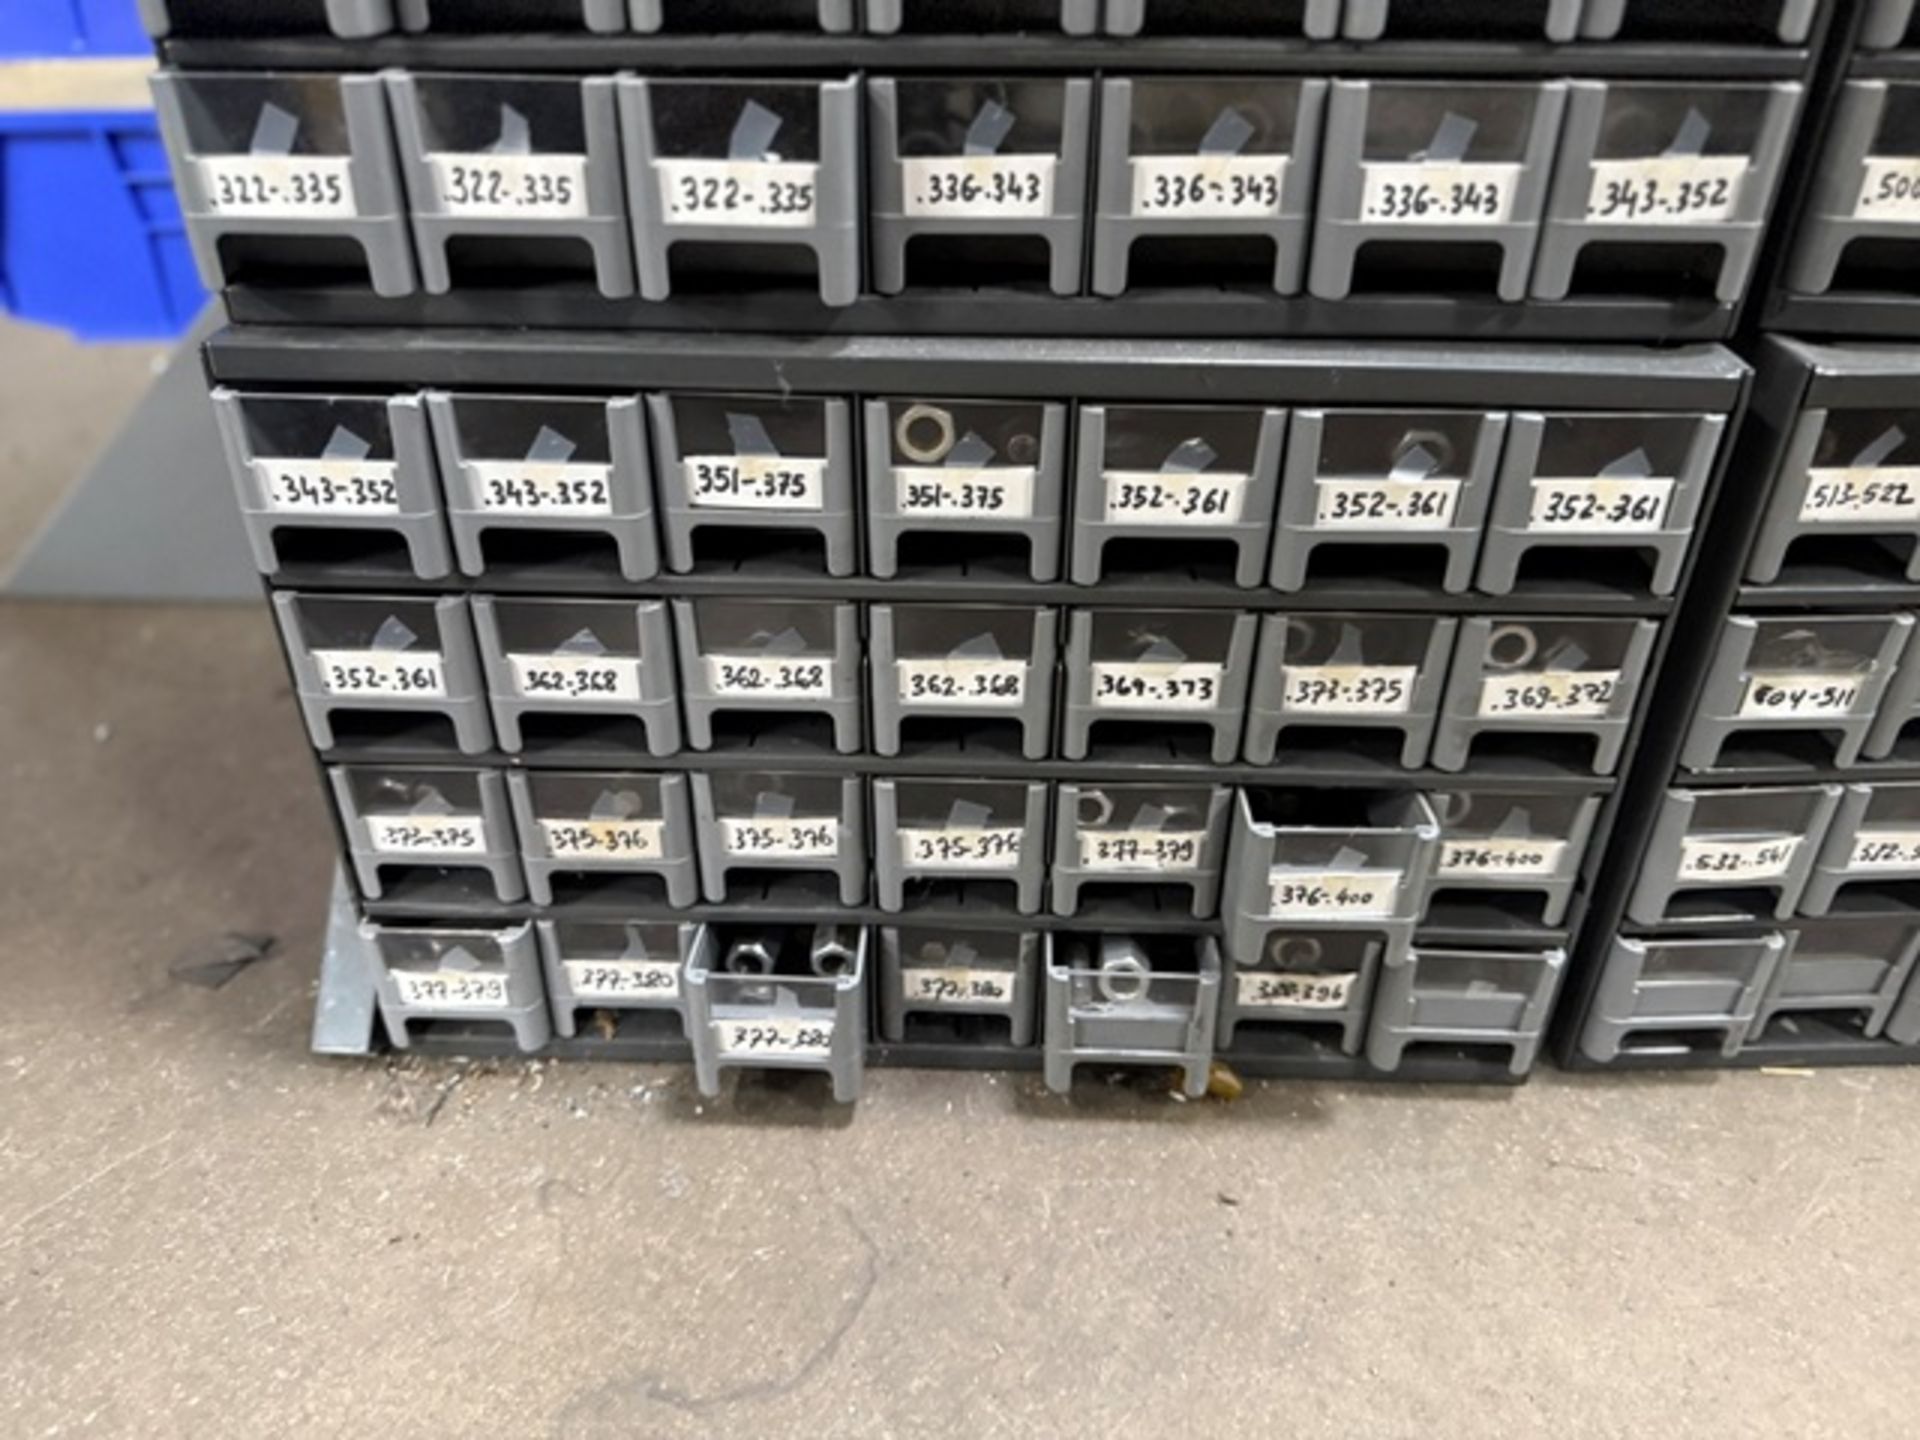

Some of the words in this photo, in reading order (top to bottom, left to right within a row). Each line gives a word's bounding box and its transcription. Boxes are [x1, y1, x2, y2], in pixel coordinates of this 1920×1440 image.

[210, 173, 342, 206] .322-.335
[444, 167, 572, 205] .322-.335
[671, 177, 813, 213] .322-.335
[917, 172, 1040, 204] .336-.343
[1143, 173, 1278, 208] .336-.343
[1368, 184, 1498, 218] .336-.343
[1587, 178, 1728, 217] .343-.352
[273, 475, 397, 505] .343-.352
[484, 480, 607, 506] .343-.352
[695, 464, 807, 498] .351-.375
[901, 484, 1004, 509] .351-.375
[1110, 485, 1229, 515] .352-.361
[1319, 492, 1448, 520] .352-.361
[324, 666, 436, 690] .352-.361
[524, 670, 617, 696] .362-.368
[1097, 674, 1213, 699] .369-.373
